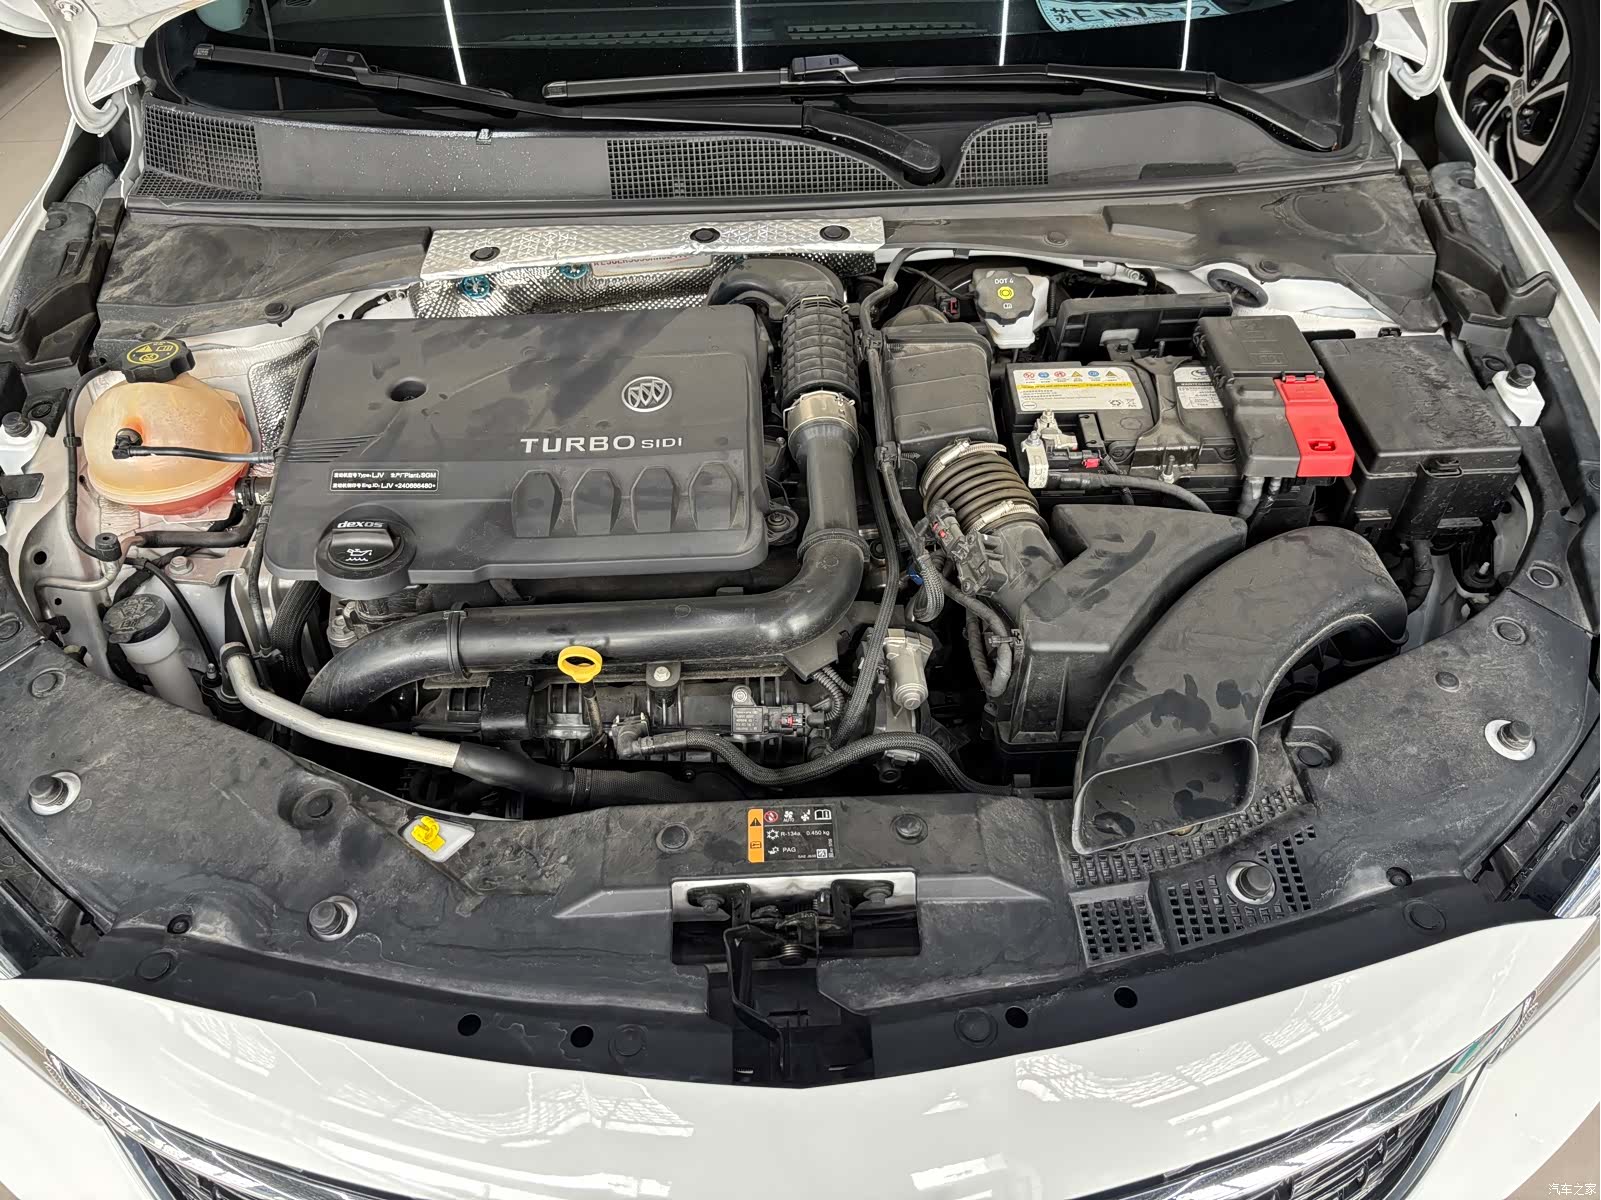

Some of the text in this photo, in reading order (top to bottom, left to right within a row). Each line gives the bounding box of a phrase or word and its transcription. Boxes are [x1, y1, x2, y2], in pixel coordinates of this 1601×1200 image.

[520, 435, 683, 454] TURBO SIDI
[337, 521, 384, 529] dexos
